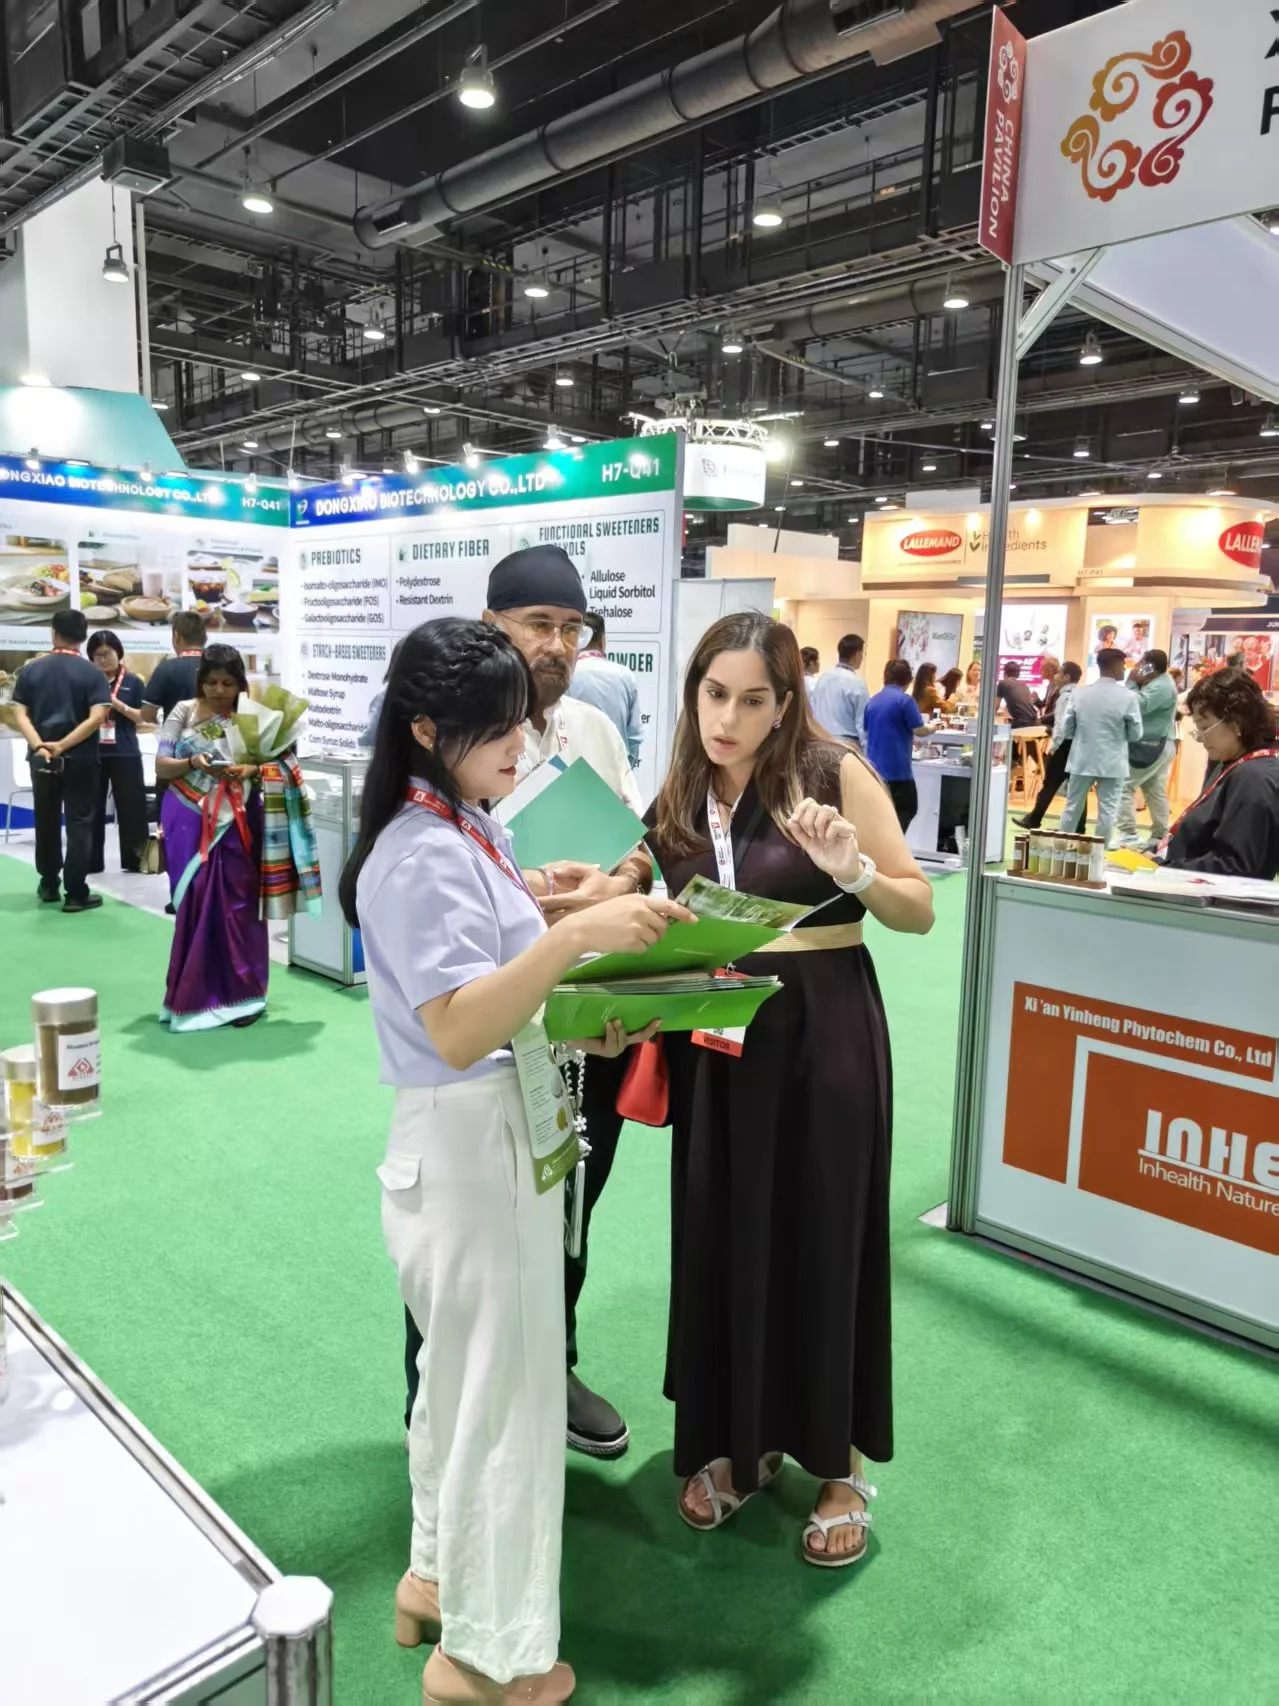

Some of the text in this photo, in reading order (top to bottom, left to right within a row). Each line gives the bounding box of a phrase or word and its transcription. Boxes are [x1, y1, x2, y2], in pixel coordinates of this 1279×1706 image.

[1000, 119, 1014, 202] CHINA
[988, 108, 1005, 239] PAVILION
[602, 458, 660, 482] H7-Q41
[0, 468, 65, 488] ONGXIAO
[68, 476, 170, 500] BIOTEHNOLOGY
[242, 497, 281, 511] H7-Q41
[380, 480, 486, 509] BIOTECHNOLOGY
[540, 517, 660, 541] FUNCTIONAL SWEETENERS
[413, 539, 489, 560] DIETARY FIBER
[903, 536, 960, 550] LALLEMAND
[981, 540, 1048, 552] Inedients
[311, 548, 361, 566] PREBIOTICS
[399, 576, 441, 589] Polydextrose
[590, 569, 626, 582] Allulose
[400, 594, 453, 605] Resistant Dextrin
[590, 584, 656, 601] Liquid Sorbitol
[604, 653, 654, 672] WDER
[1025, 996, 1037, 1012] Xi
[1063, 1005, 1120, 1033] Yinheng
[1123, 1019, 1210, 1053] Phytochem
[1213, 1040, 1242, 1062] Co.,
[1245, 1047, 1273, 1067] Ltd
[703, 1036, 730, 1050] VISITOR
[1139, 1157, 1279, 1216] Inhealth Nature
